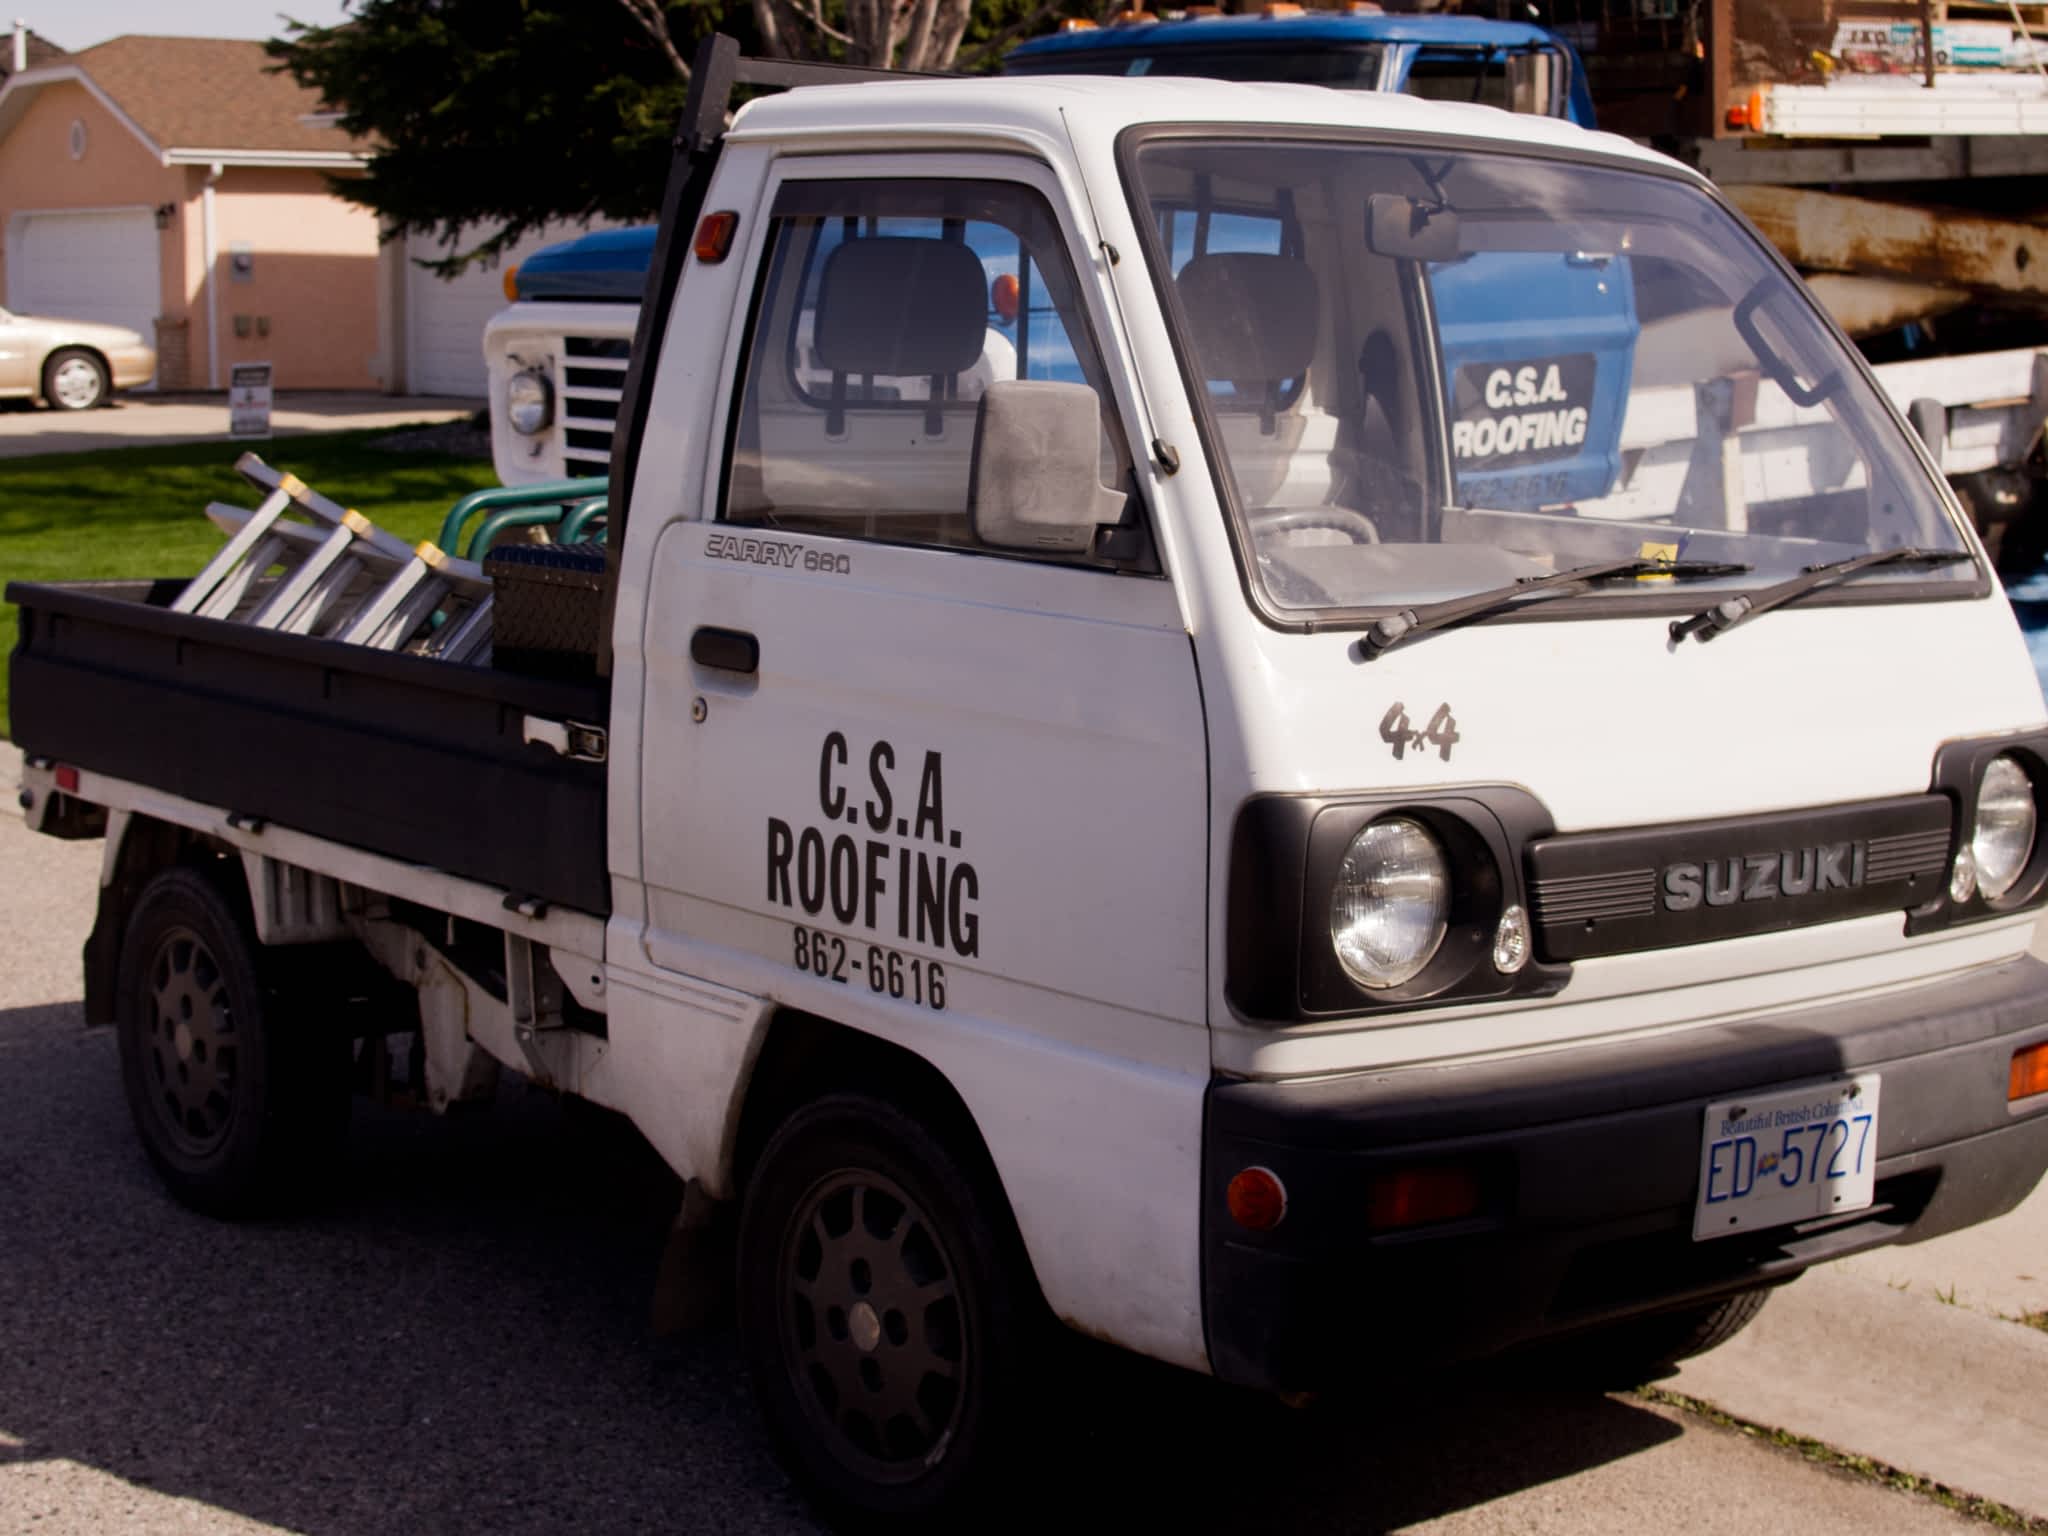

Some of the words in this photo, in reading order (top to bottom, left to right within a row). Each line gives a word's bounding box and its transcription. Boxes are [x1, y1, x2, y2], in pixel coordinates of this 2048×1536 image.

[1485, 364, 1568, 409] C.S.A.
[1452, 406, 1588, 458] ROOFING
[704, 533, 803, 568] CARRY
[804, 550, 851, 574] 660
[1379, 701, 1460, 762] 4x4
[819, 731, 962, 849] C.S.A.
[768, 816, 979, 959] ROOFING
[1664, 841, 1865, 912] SUZUKI
[793, 926, 946, 1010] 862-6616
[1720, 1111, 1773, 1136] Beautiful
[1775, 1105, 1811, 1127] British
